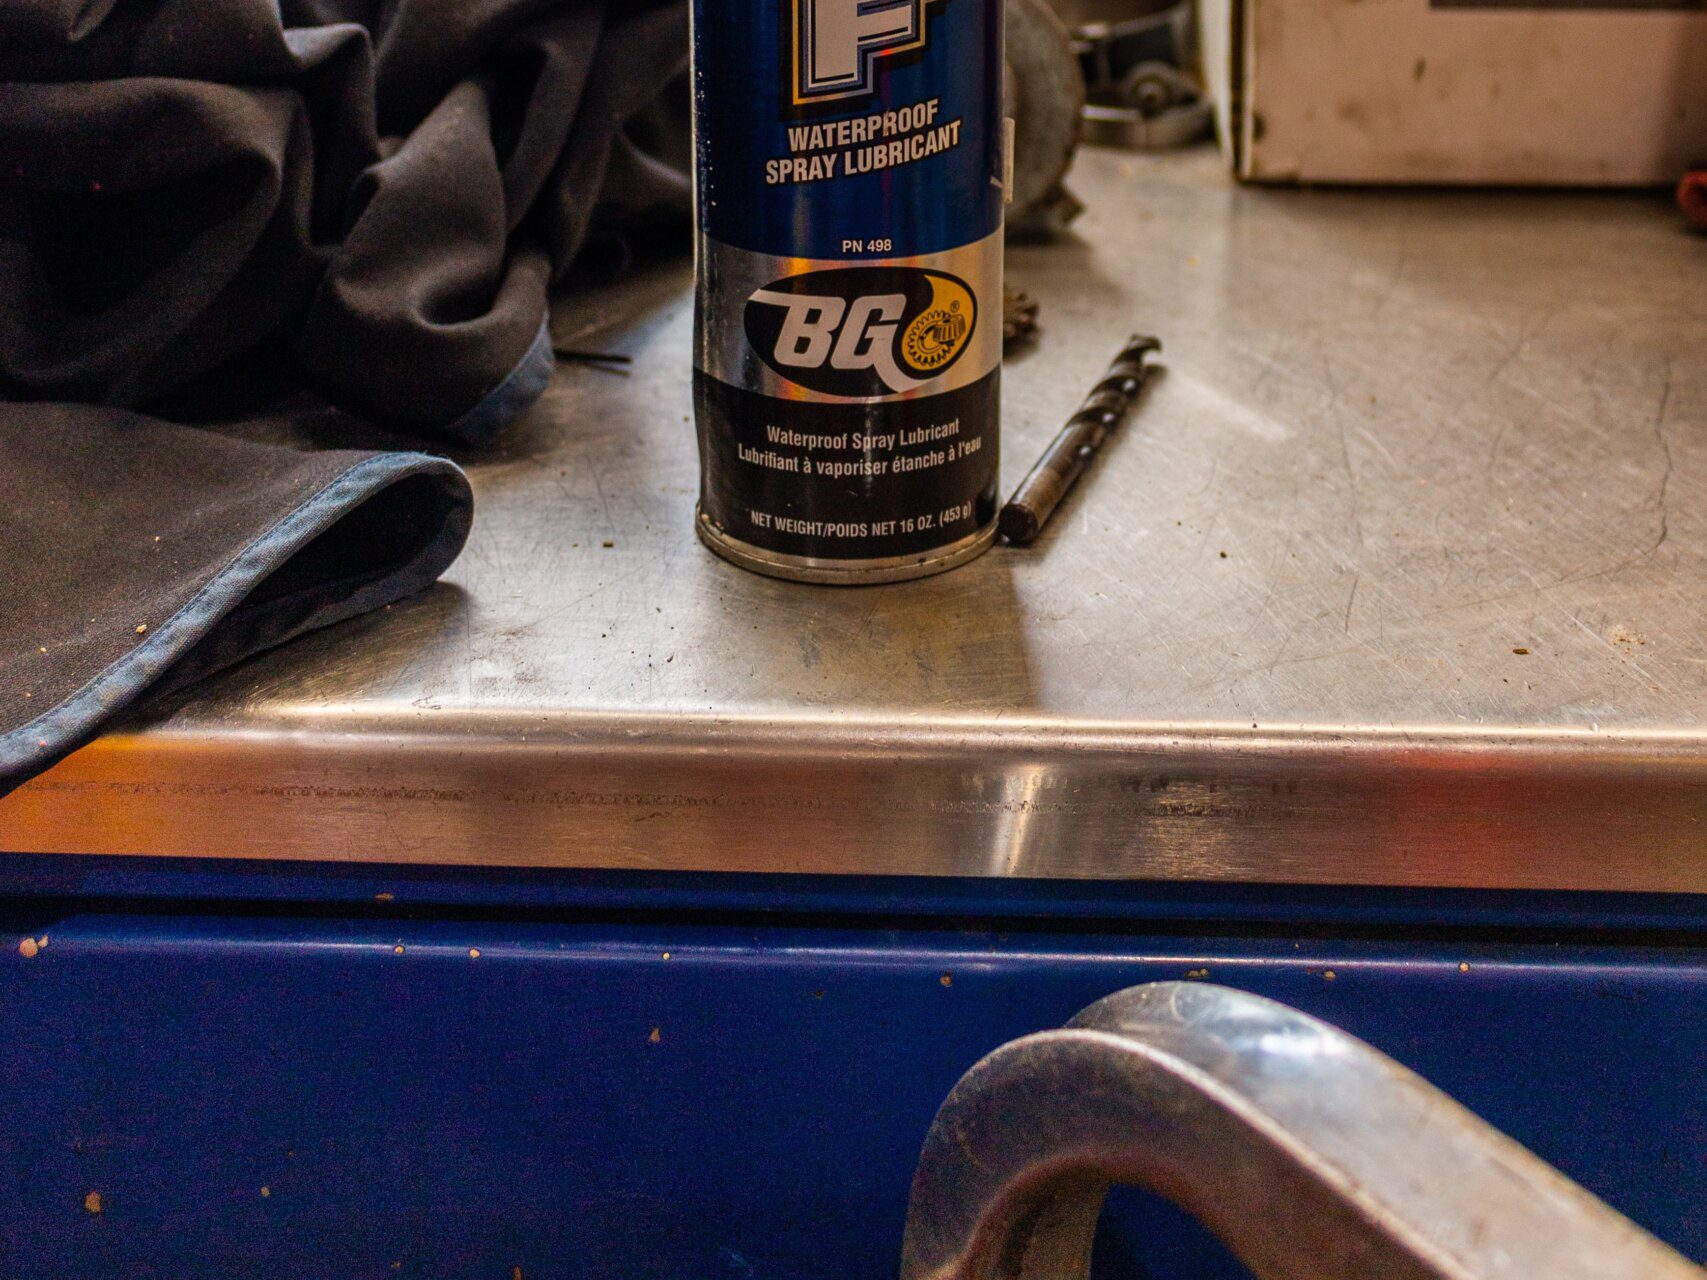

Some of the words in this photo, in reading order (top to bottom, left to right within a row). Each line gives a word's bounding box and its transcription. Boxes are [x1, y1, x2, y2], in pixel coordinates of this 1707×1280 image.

[788, 98, 939, 152] WATERPROOF
[766, 153, 838, 185] SPRAY
[844, 120, 961, 176] LUBRICANT
[842, 239, 863, 253] PN
[866, 238, 892, 252] 498
[748, 290, 922, 393] BG
[766, 424, 847, 451] Waterproof
[852, 433, 895, 452] Spray
[900, 418, 960, 446] Lubricant
[738, 443, 799, 472] Lubrifiant
[803, 456, 811, 474] à
[816, 459, 888, 478] vaporiser
[892, 448, 945, 473] étanche
[948, 444, 956, 461] à
[958, 436, 982, 458] l'eau
[751, 510, 772, 528] NET
[775, 516, 868, 538] WEIGHT/POIDS
[872, 521, 896, 536] NET
[900, 519, 914, 533] 16
[918, 515, 936, 530] OZ.
[939, 506, 961, 527] (453
[962, 501, 972, 519] g)
